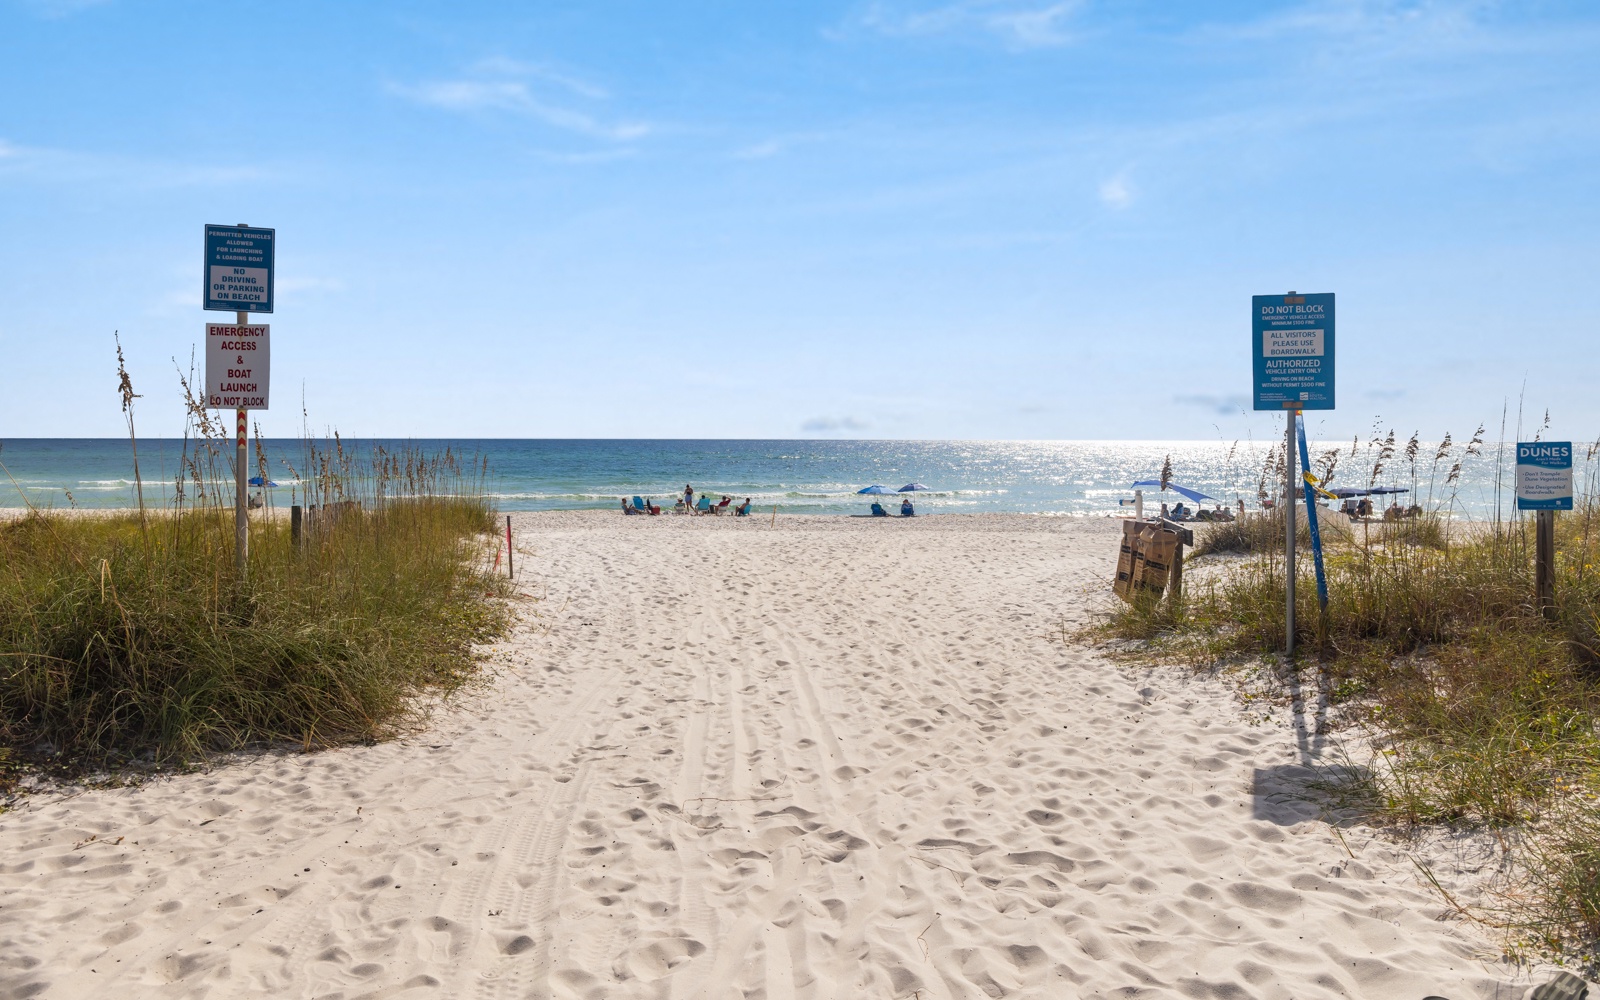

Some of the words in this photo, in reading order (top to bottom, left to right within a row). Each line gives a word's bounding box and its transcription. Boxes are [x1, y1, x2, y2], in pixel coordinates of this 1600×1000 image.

[210, 327, 265, 336] EMERGENCY
[221, 341, 256, 350] ACCESS
[237, 356, 243, 364] &
[1266, 359, 1320, 368] AUTHORIZED
[228, 369, 251, 378] BOAT
[221, 383, 257, 392] LAUNCH
[224, 397, 240, 405] NOT
[243, 397, 264, 406] BLOCK
[1520, 447, 1568, 457] DUNES
